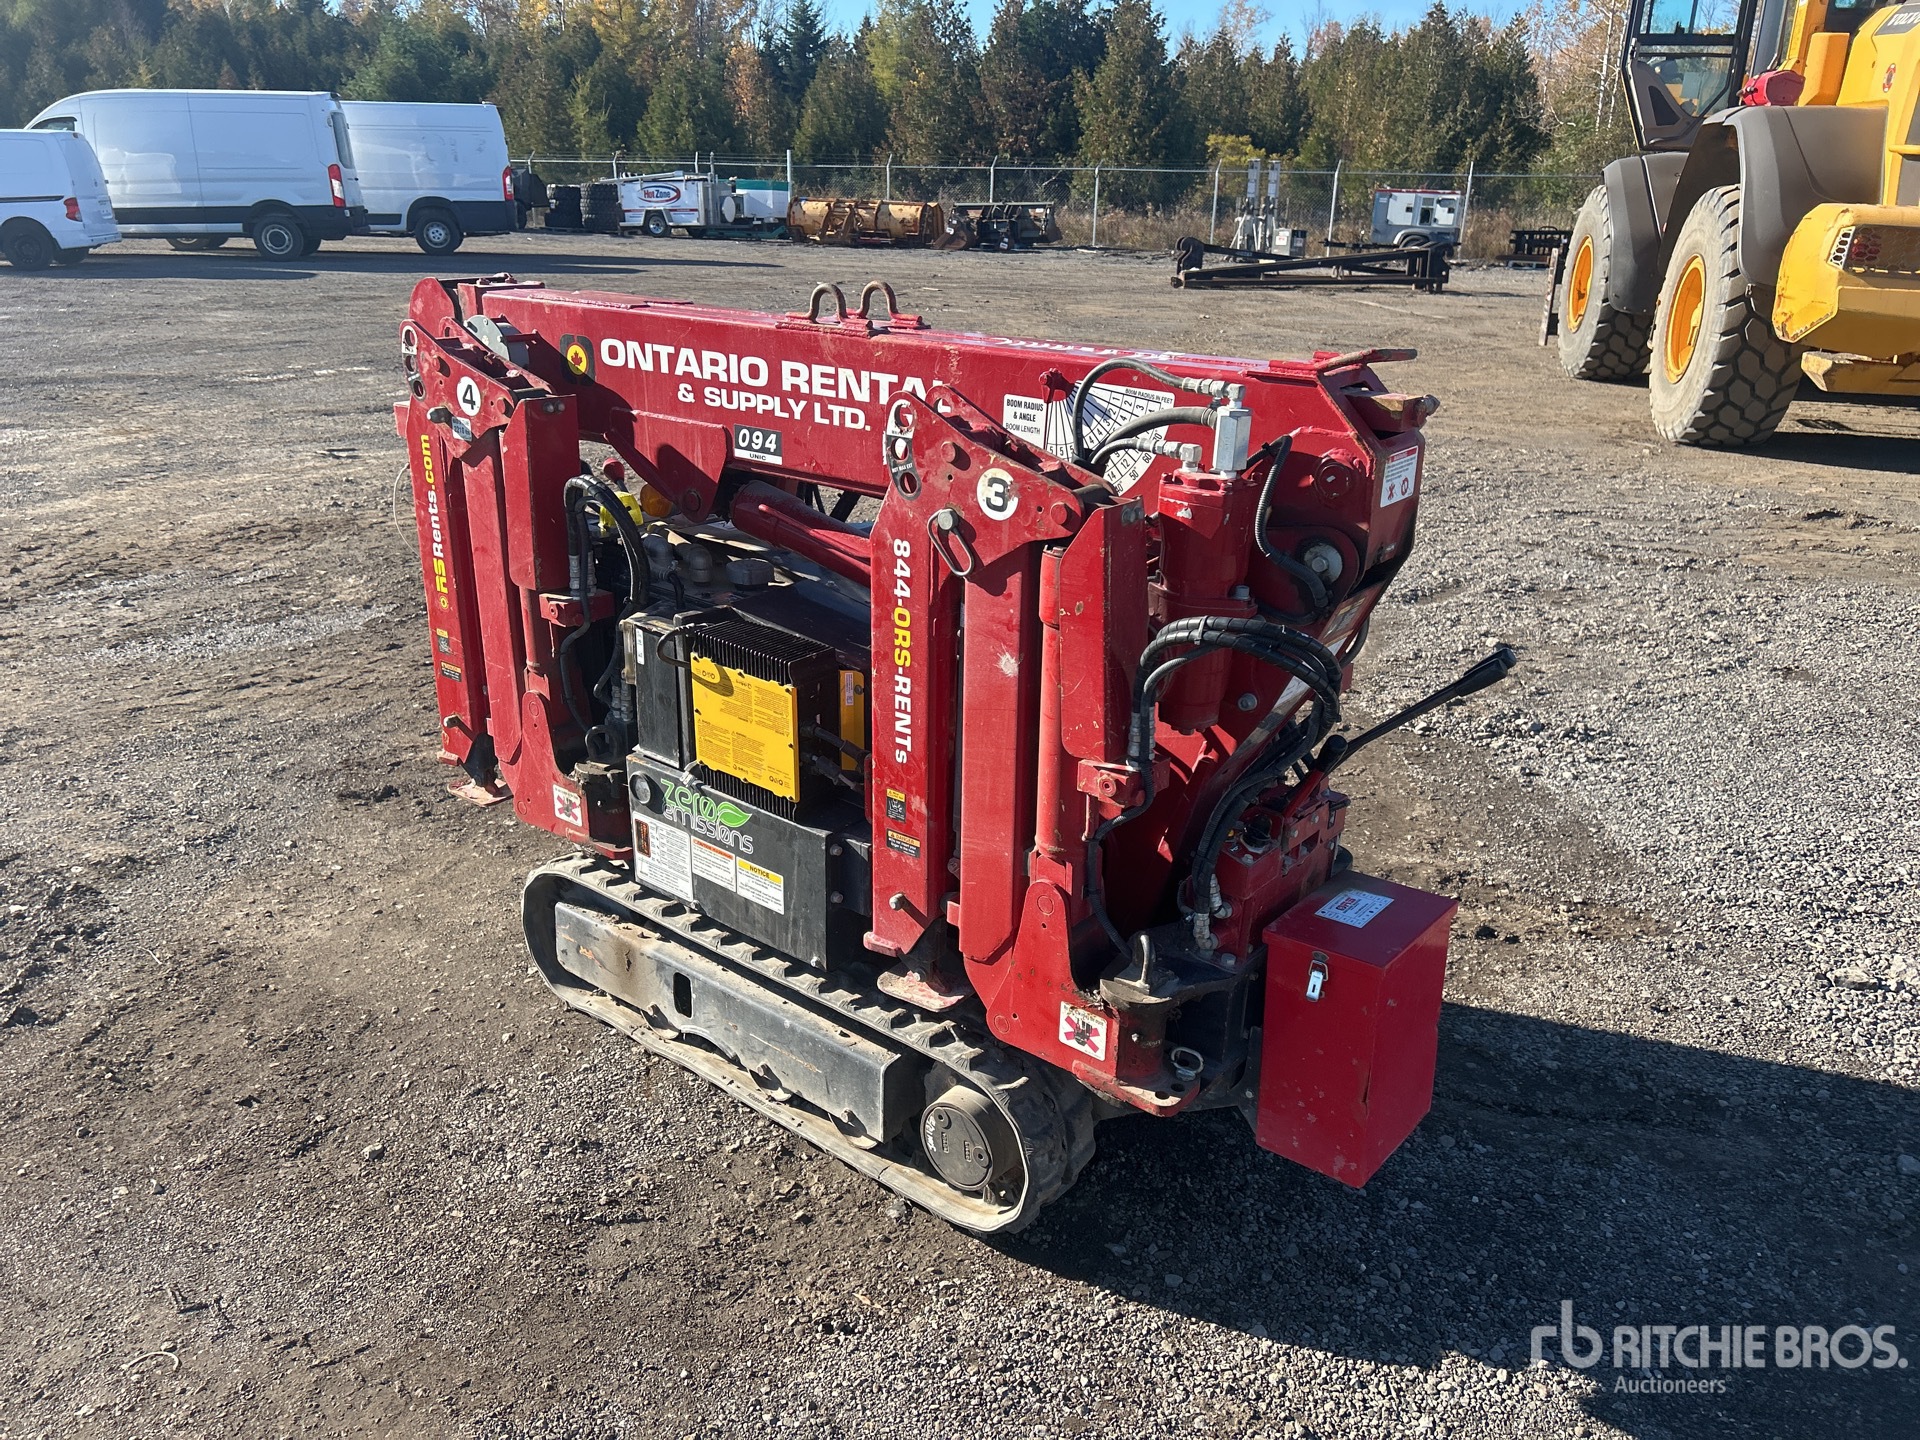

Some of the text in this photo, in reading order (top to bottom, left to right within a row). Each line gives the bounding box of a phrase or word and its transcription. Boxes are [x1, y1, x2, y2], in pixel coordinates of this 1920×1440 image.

[600, 338, 769, 387] ONTARIO
[462, 384, 476, 410] 4
[1006, 398, 1044, 412] BOOM RADIUS
[1124, 388, 1138, 396] BOOM
[1137, 390, 1156, 401] RADIUS
[1161, 395, 1174, 404] FEET
[677, 383, 872, 432] & SUPPLY LTD.
[1013, 411, 1036, 422] & ANGLE
[1006, 422, 1041, 435] BOOM LENGTH
[737, 427, 778, 454] 094
[749, 452, 767, 461] UNIC
[985, 476, 1009, 513] 3
[663, 803, 754, 855] emissions
[749, 864, 770, 879] NOTICE
